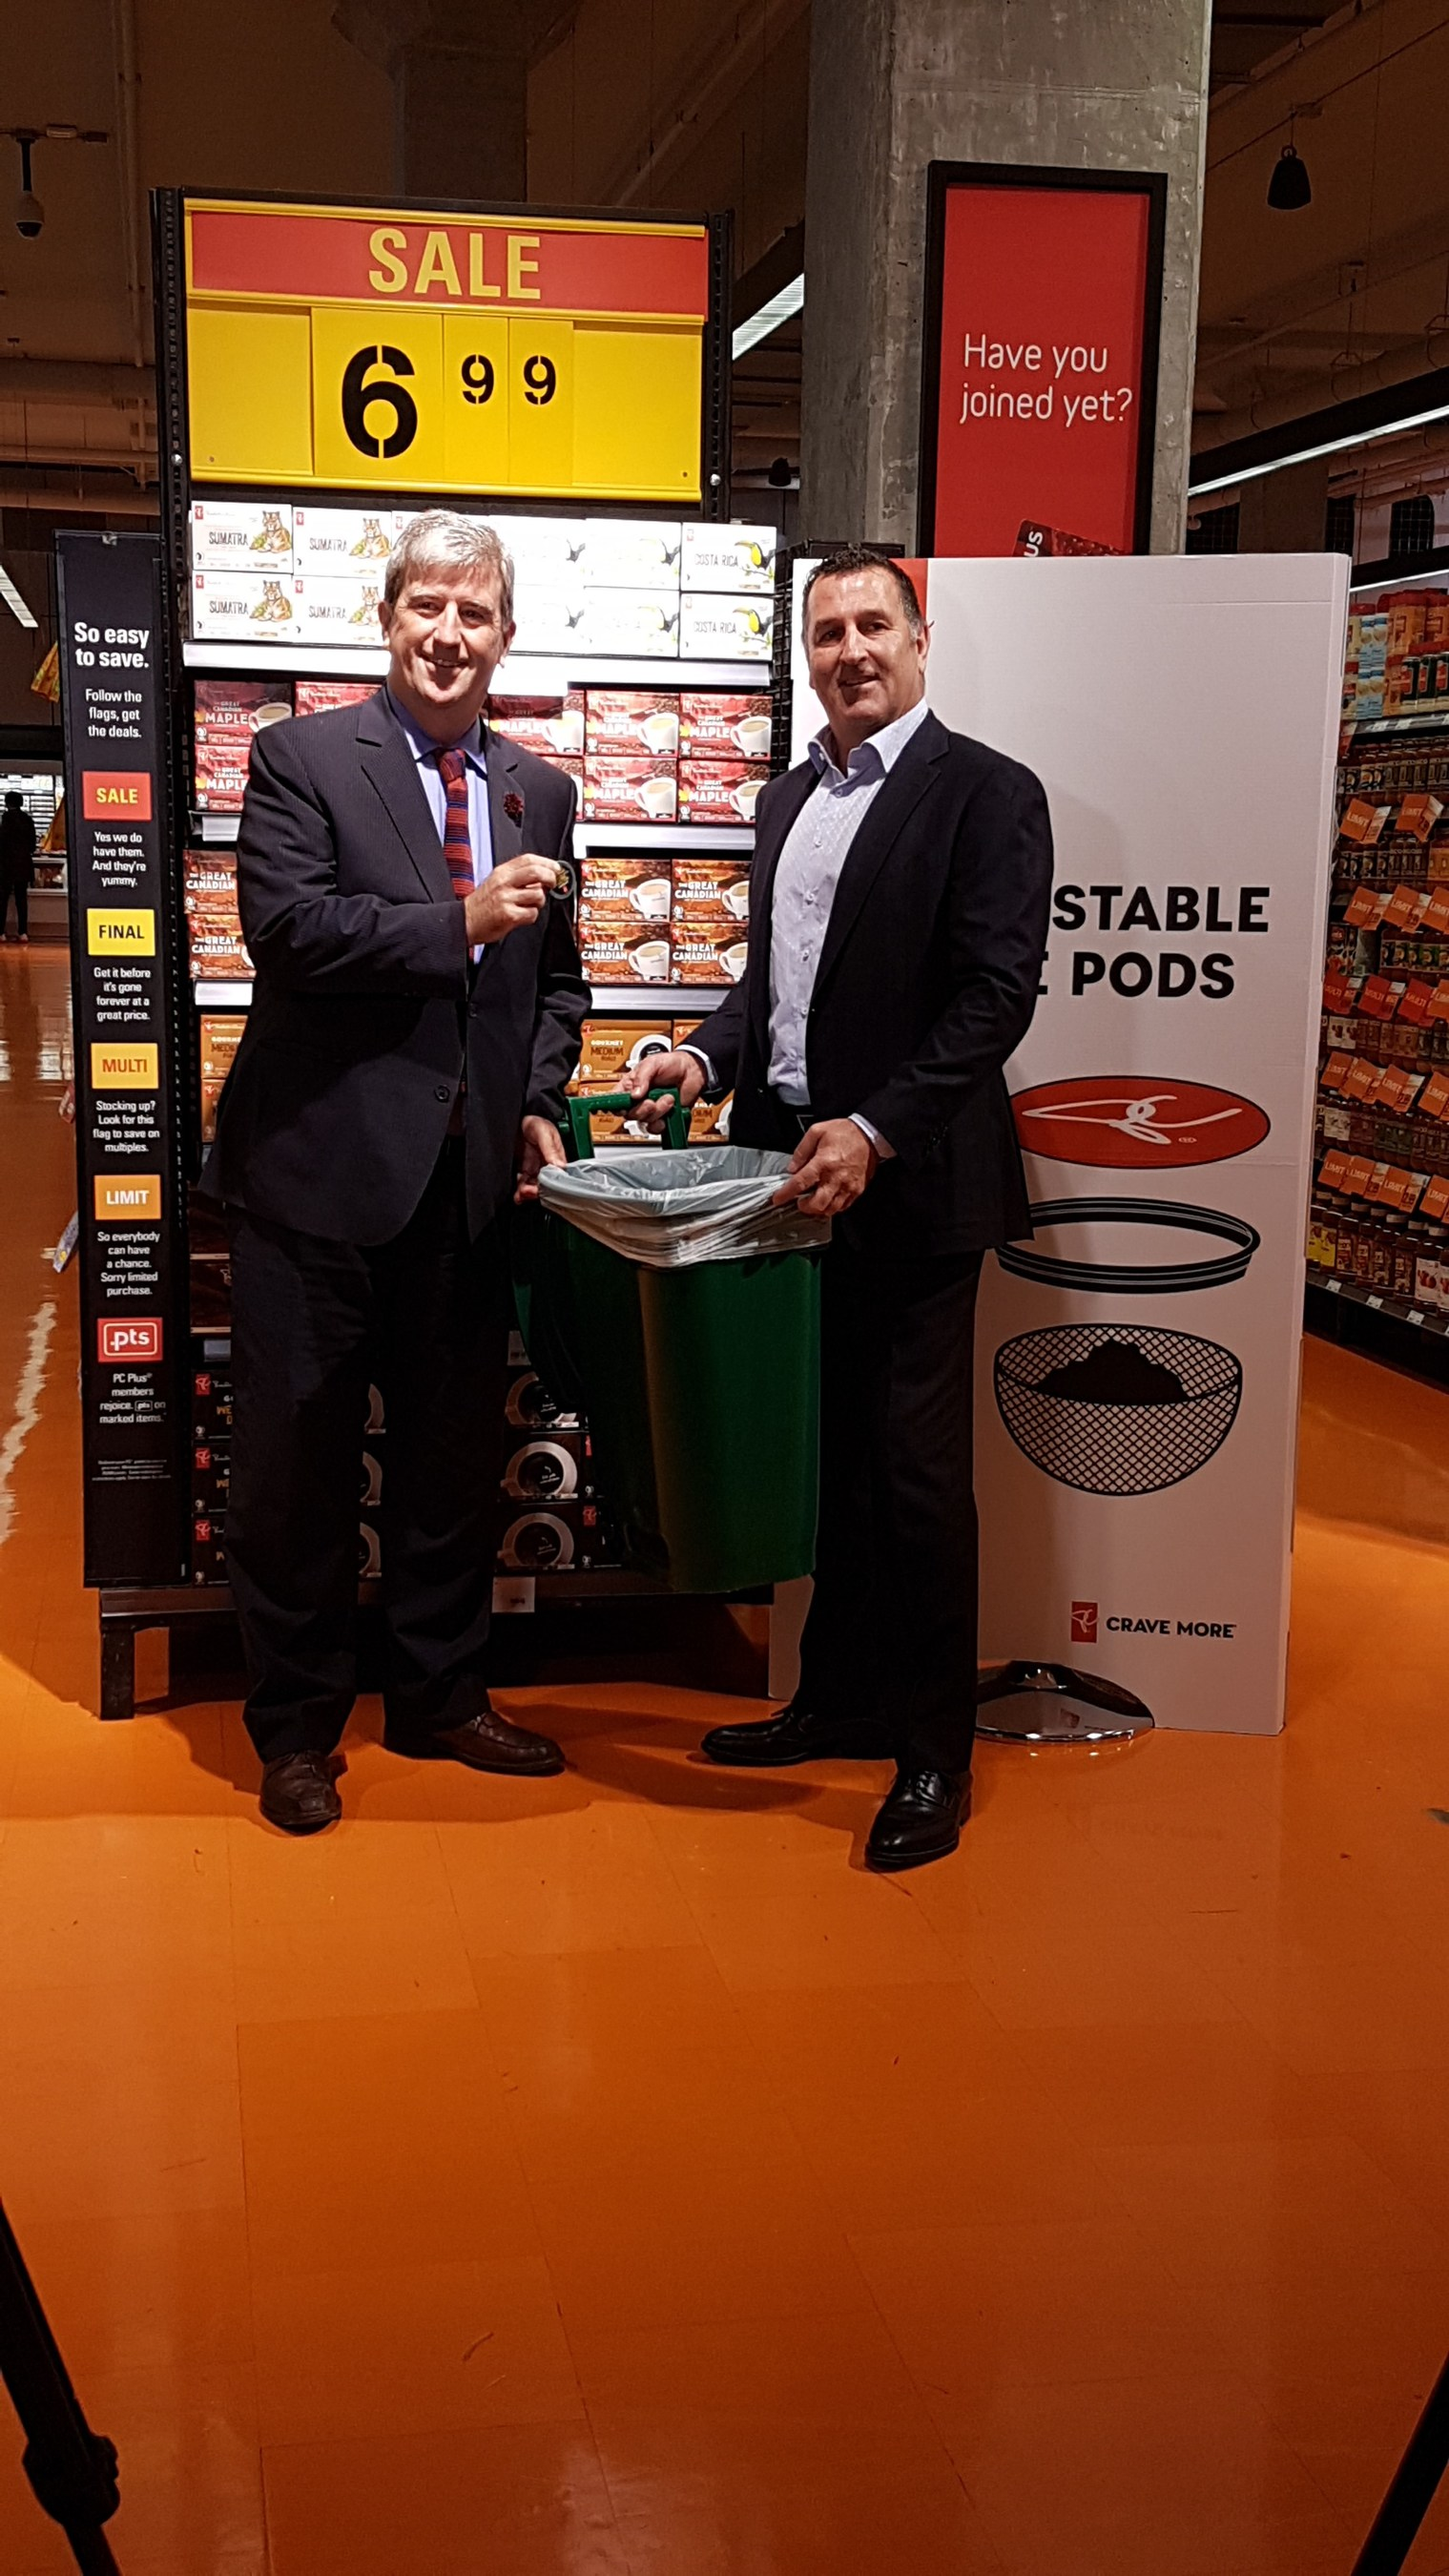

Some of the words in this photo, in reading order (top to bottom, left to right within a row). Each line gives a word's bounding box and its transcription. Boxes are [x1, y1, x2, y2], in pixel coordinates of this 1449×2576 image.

[368, 227, 542, 301] SALE
[963, 333, 1042, 371] Have
[1052, 345, 1107, 379] you
[341, 344, 418, 459] 6
[960, 382, 1053, 425] joined
[1063, 387, 1133, 427] yet?
[209, 531, 248, 546] SUMATRA
[309, 537, 348, 551] SUMATRA
[694, 553, 718, 566] COSTA
[721, 553, 738, 567] RICA
[209, 600, 249, 615] SUMATRA
[308, 606, 346, 619] SUMATRA
[693, 621, 717, 634] COSTA
[719, 621, 736, 634] RICA
[73, 622, 100, 643] So
[104, 628, 150, 650] easy
[75, 649, 94, 666] to
[99, 652, 149, 668] save.
[86, 689, 122, 701] Follow
[124, 690, 142, 702] the
[89, 707, 119, 721] flags,
[122, 709, 140, 722] get
[205, 712, 248, 724] MAPLE
[88, 725, 106, 737] the
[109, 726, 141, 737] deals.
[690, 726, 731, 738] MAPLE
[96, 787, 138, 803] SALE
[594, 788, 635, 800] MAPLE
[689, 791, 730, 802] MAPLE
[1346, 812, 1371, 827] LIMIT
[94, 831, 112, 842] Yes
[113, 833, 128, 842] we
[130, 832, 142, 842] do
[93, 846, 116, 857] have
[118, 846, 144, 857] them.
[93, 861, 112, 871] And
[114, 861, 147, 873] they're
[101, 877, 138, 887] yummy.
[200, 872, 232, 881] GREAT
[186, 881, 236, 889] CANADIAN
[594, 880, 626, 888] GREAT
[1052, 884, 1270, 932] STABLE
[98, 924, 145, 939] FINAL
[204, 936, 238, 945] GREAT
[192, 945, 240, 954] CANADIAN
[93, 966, 111, 978] Get
[113, 967, 118, 978] it
[120, 967, 151, 978] before
[1071, 951, 1234, 999] PODS
[103, 982, 116, 992] it's
[118, 984, 142, 994] gone
[96, 995, 130, 1006] forever
[133, 997, 142, 1007] at
[143, 998, 150, 1007] a
[96, 1010, 122, 1022] great
[123, 1009, 151, 1022] price.
[590, 1047, 624, 1055] MEDIUM
[102, 1058, 148, 1072] MULTI
[1382, 1077, 1402, 1093] LIMIT
[1427, 1085, 1448, 1102] LIMIT
[95, 1100, 136, 1112] Stocking
[138, 1100, 156, 1112] up?
[97, 1114, 120, 1125] Look
[122, 1114, 135, 1125] for
[137, 1114, 155, 1125] this
[93, 1129, 111, 1140] flag
[113, 1129, 122, 1138] to
[124, 1130, 146, 1138] save
[148, 1130, 160, 1138] on
[104, 1142, 149, 1153] multiples.
[1324, 1161, 1346, 1174] LIMIT
[1350, 1169, 1371, 1182] LIMIT
[1384, 1179, 1406, 1193] LIMIT
[106, 1190, 150, 1205] LIMIT
[1427, 1189, 1448, 1203] LIMIT
[97, 1231, 111, 1241] So
[112, 1231, 160, 1243] everybody
[108, 1246, 126, 1255] can
[127, 1245, 151, 1255] have
[107, 1260, 113, 1269] a
[114, 1258, 152, 1269] chance.
[100, 1272, 126, 1283] Sorry
[128, 1272, 158, 1281] limited
[107, 1286, 153, 1298] purchase.
[113, 1373, 126, 1383] PC
[112, 1386, 155, 1397] members
[99, 1400, 134, 1412] rejoice.
[99, 1414, 135, 1423] marked
[1106, 1616, 1170, 1634] CRAVE
